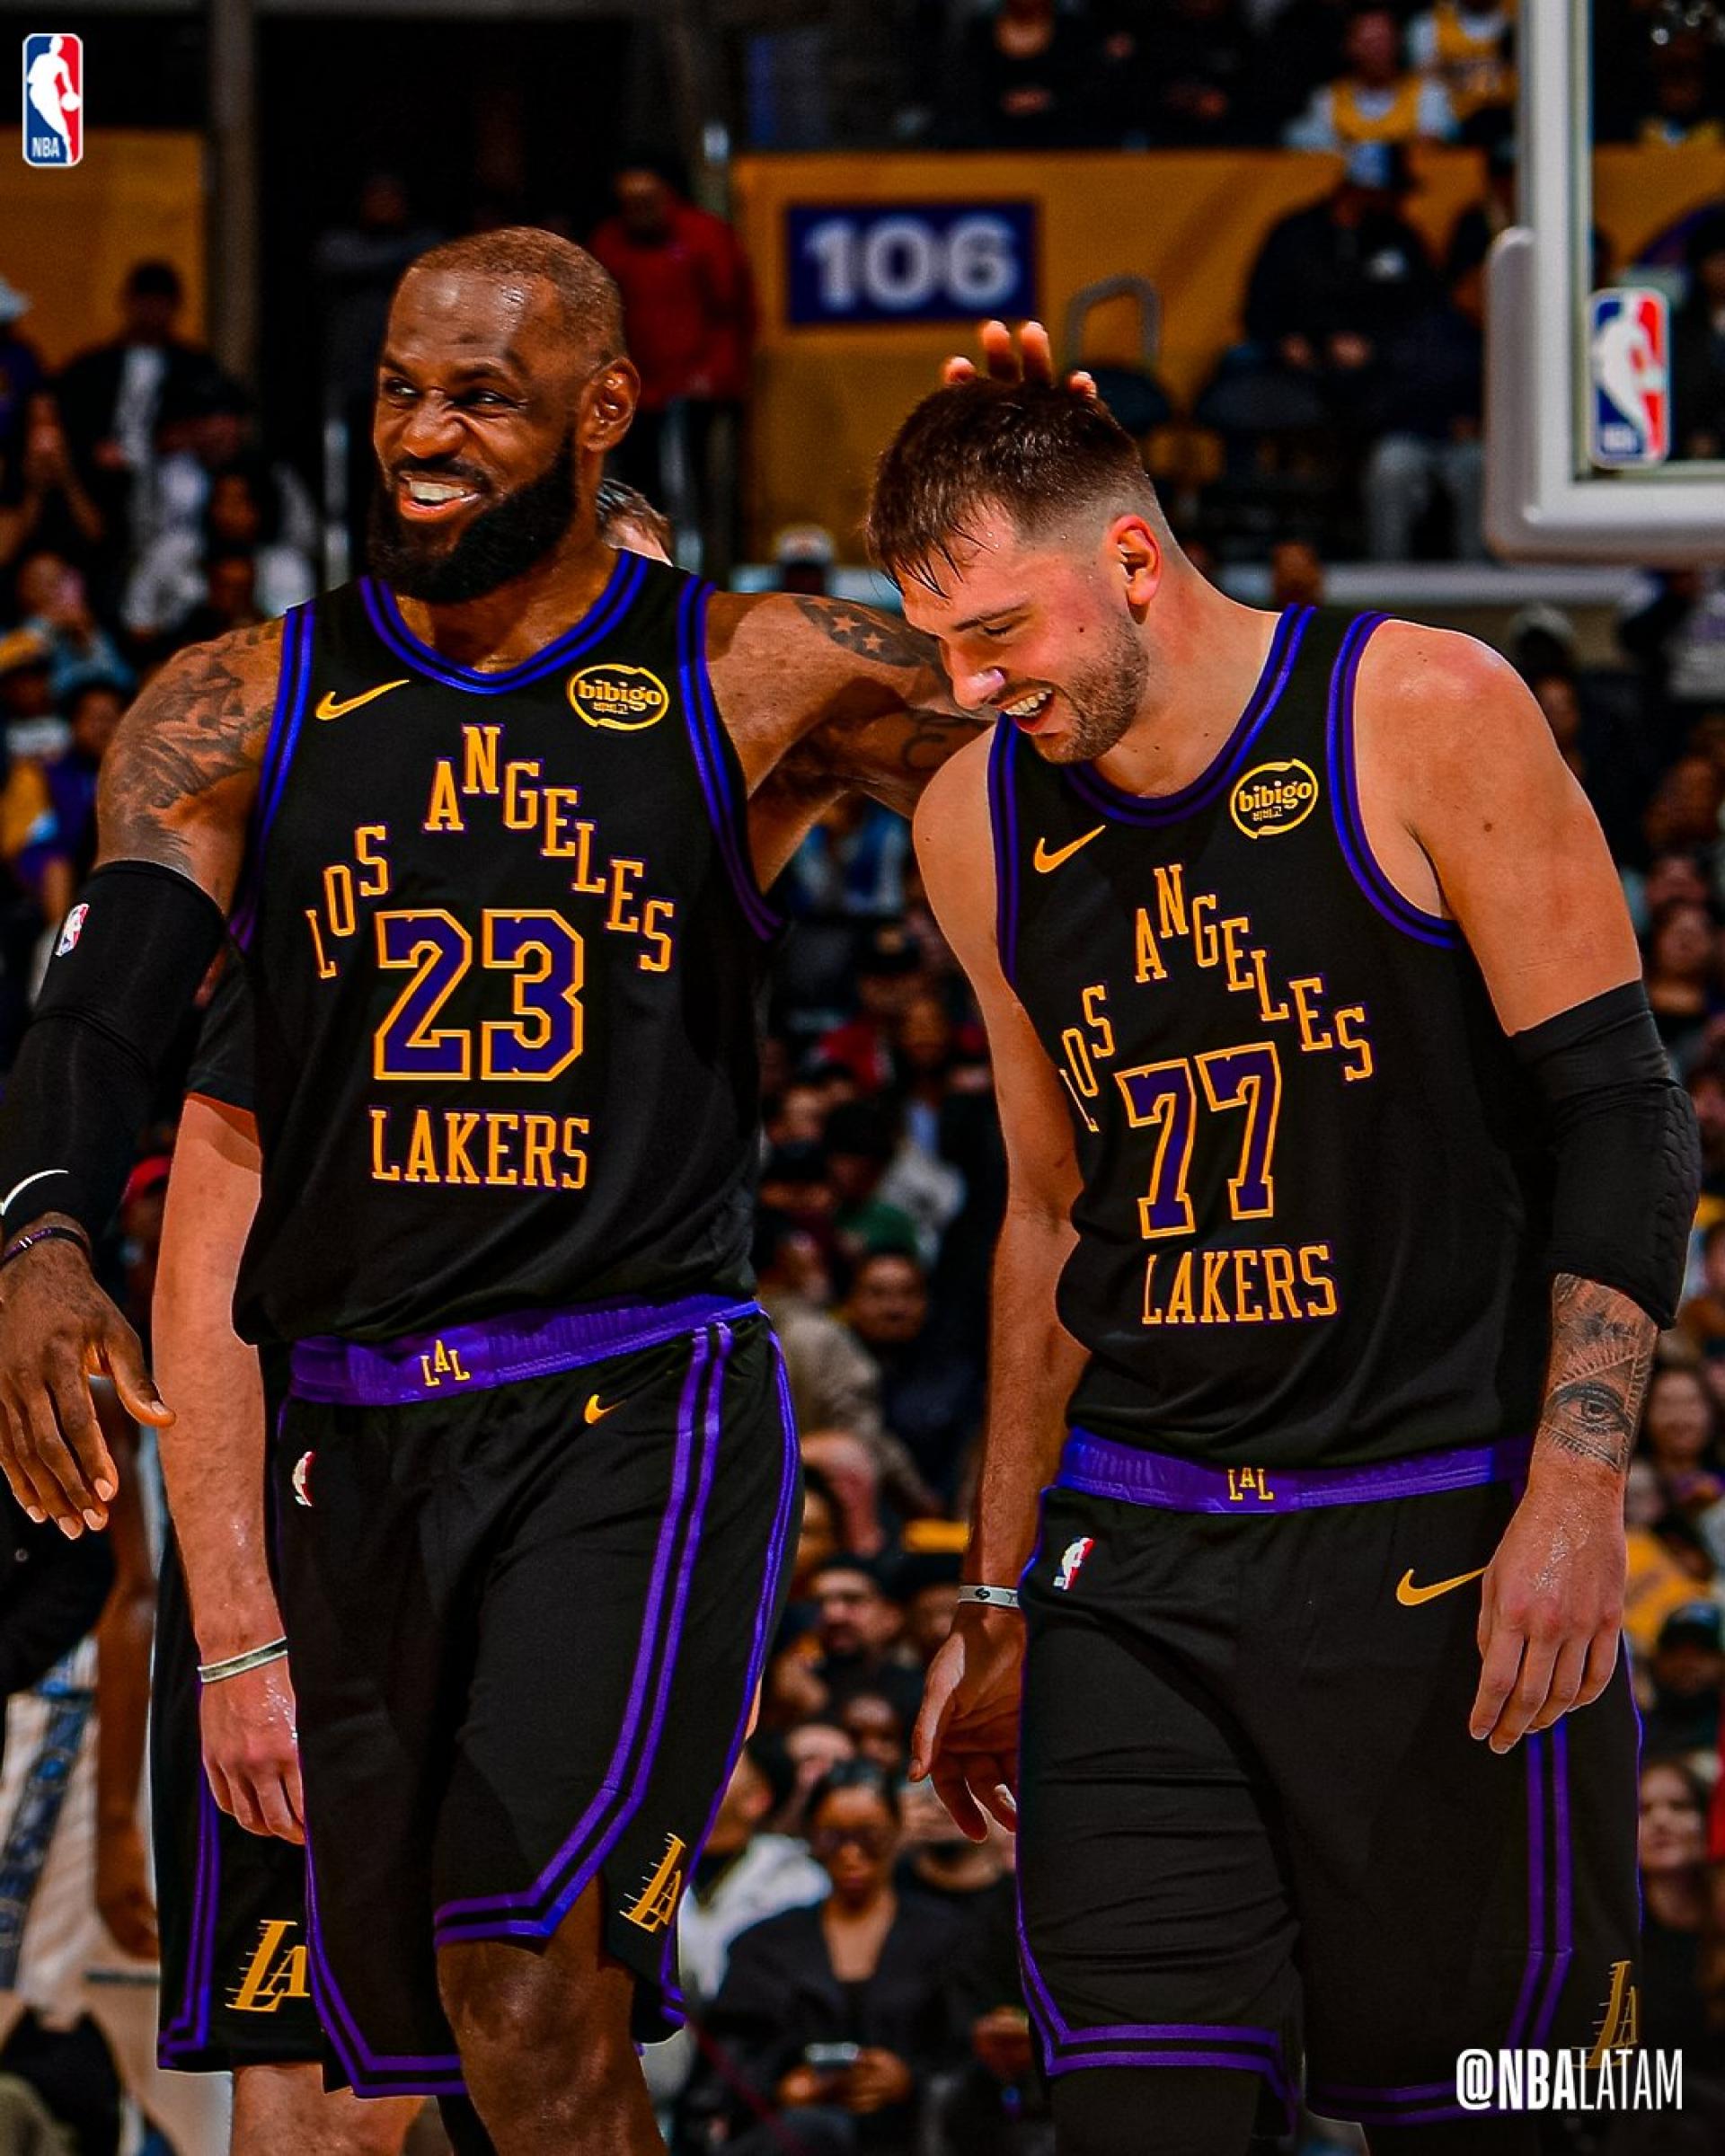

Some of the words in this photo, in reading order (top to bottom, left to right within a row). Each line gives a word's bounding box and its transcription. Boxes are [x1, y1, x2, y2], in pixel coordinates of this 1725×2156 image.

[805, 216, 1022, 312] 106
[578, 679, 662, 711] bibigo
[1239, 780, 1313, 812] bibigo
[305, 825, 390, 979] LOS
[422, 722, 675, 973] ANGELES
[373, 908, 584, 1082] 23
[1060, 985, 1116, 1133] LOS
[1135, 863, 1374, 1082] ANGELES
[369, 1108, 590, 1189] LAKERS
[1113, 1040, 1282, 1240] 77
[1142, 1244, 1338, 1325] LAKERS
[420, 1339, 471, 1387] LAL
[1227, 1467, 1274, 1501] LAL
[225, 1919, 311, 2011] LA
